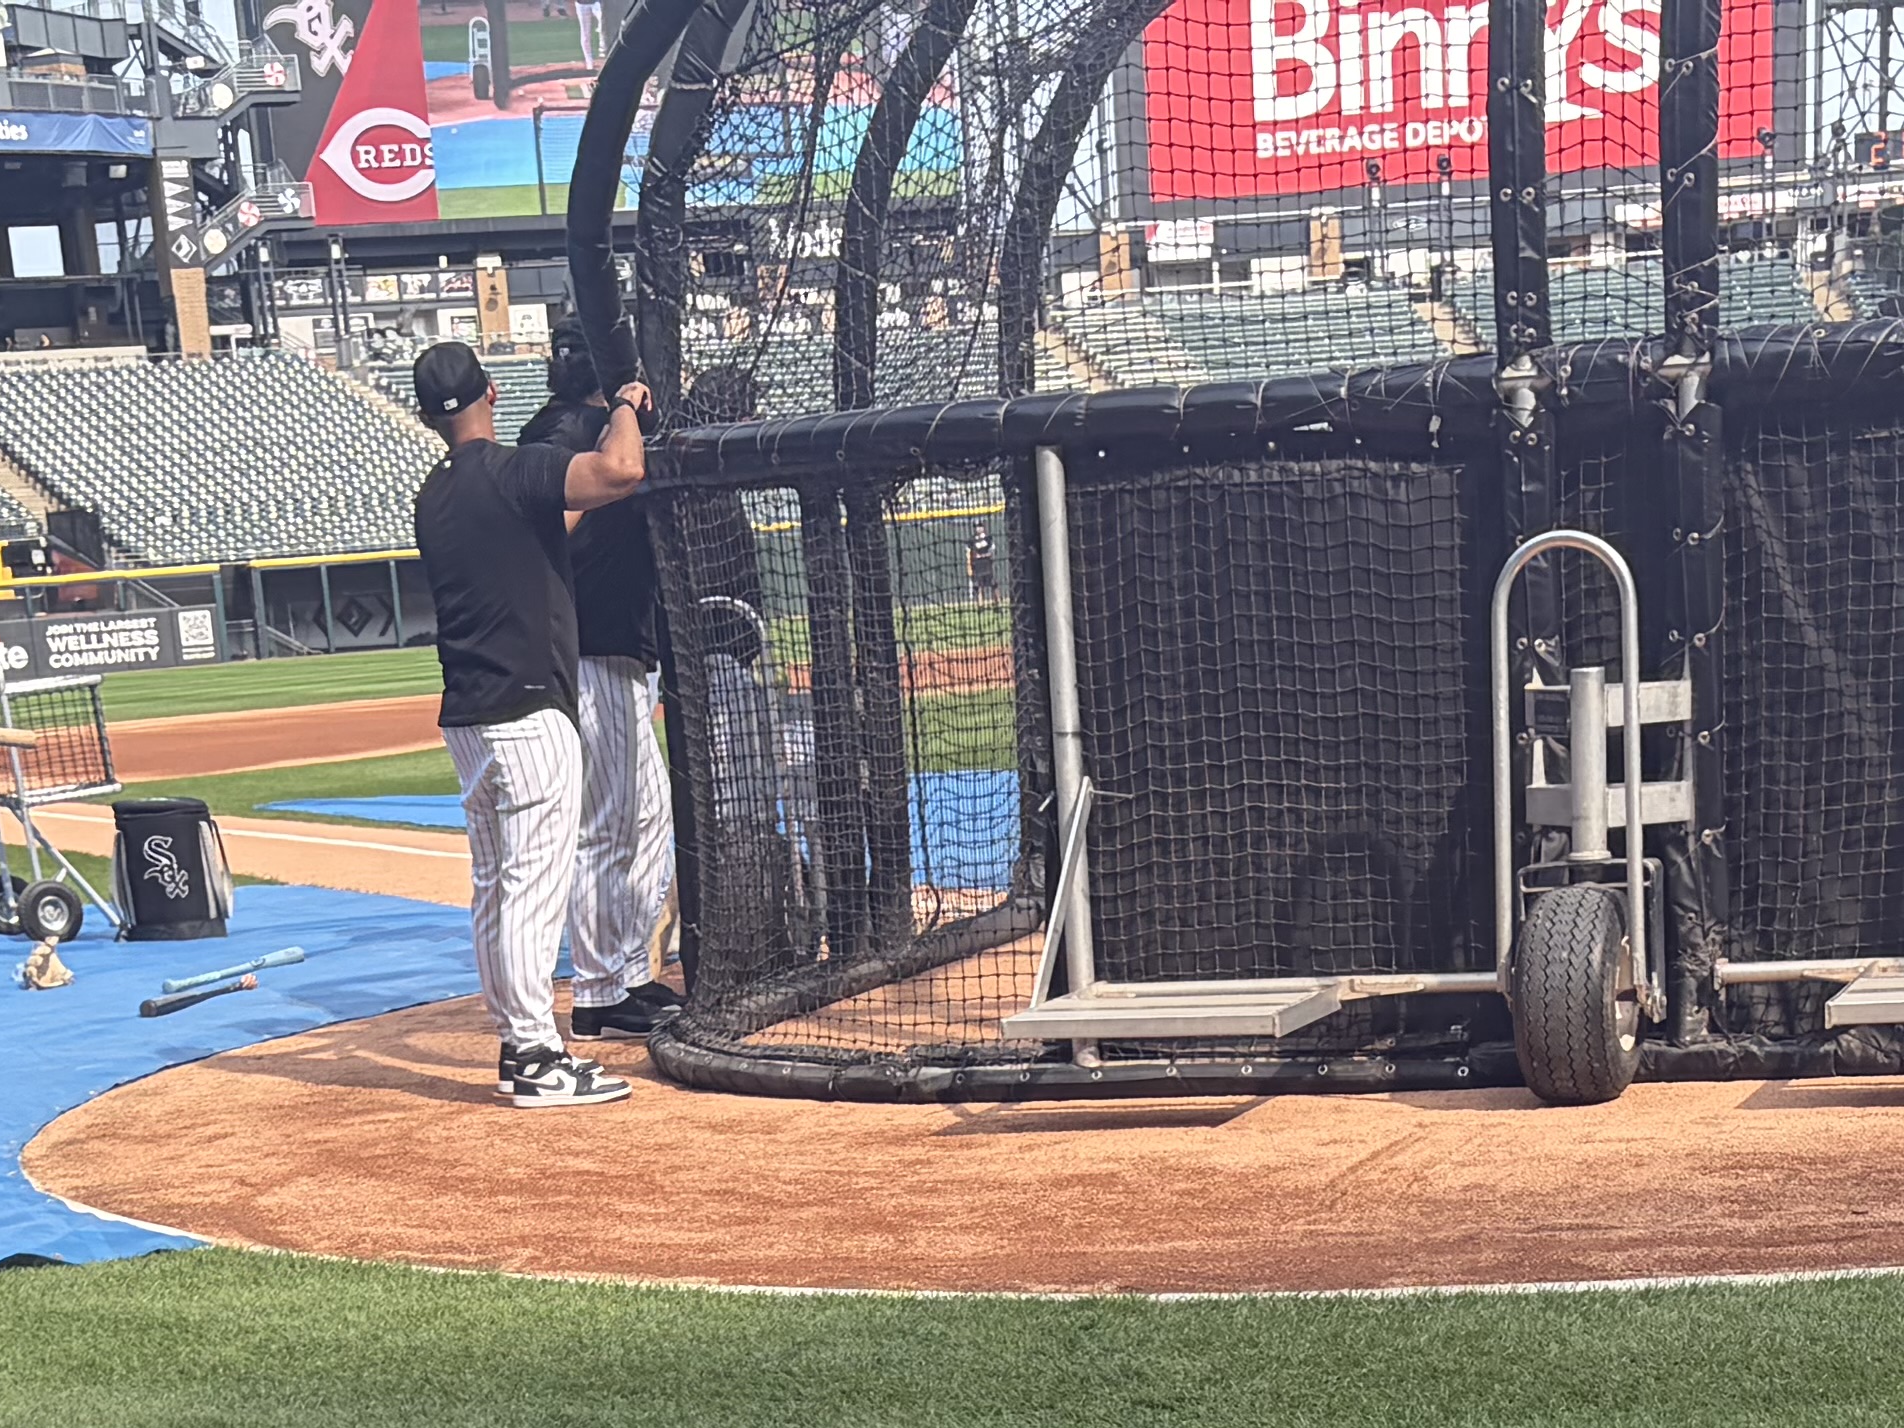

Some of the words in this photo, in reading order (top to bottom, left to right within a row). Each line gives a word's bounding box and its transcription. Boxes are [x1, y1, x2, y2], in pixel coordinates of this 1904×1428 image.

[1256, 122, 1400, 159] BEVERAGE
[1404, 115, 1490, 147] DEPO
[355, 143, 434, 169] REDS
[46, 624, 74, 637] JOIN
[74, 621, 99, 633] THE
[100, 617, 157, 631] LARGEST
[46, 629, 160, 653] WELLNESS
[49, 646, 160, 669] COMMUNITY
